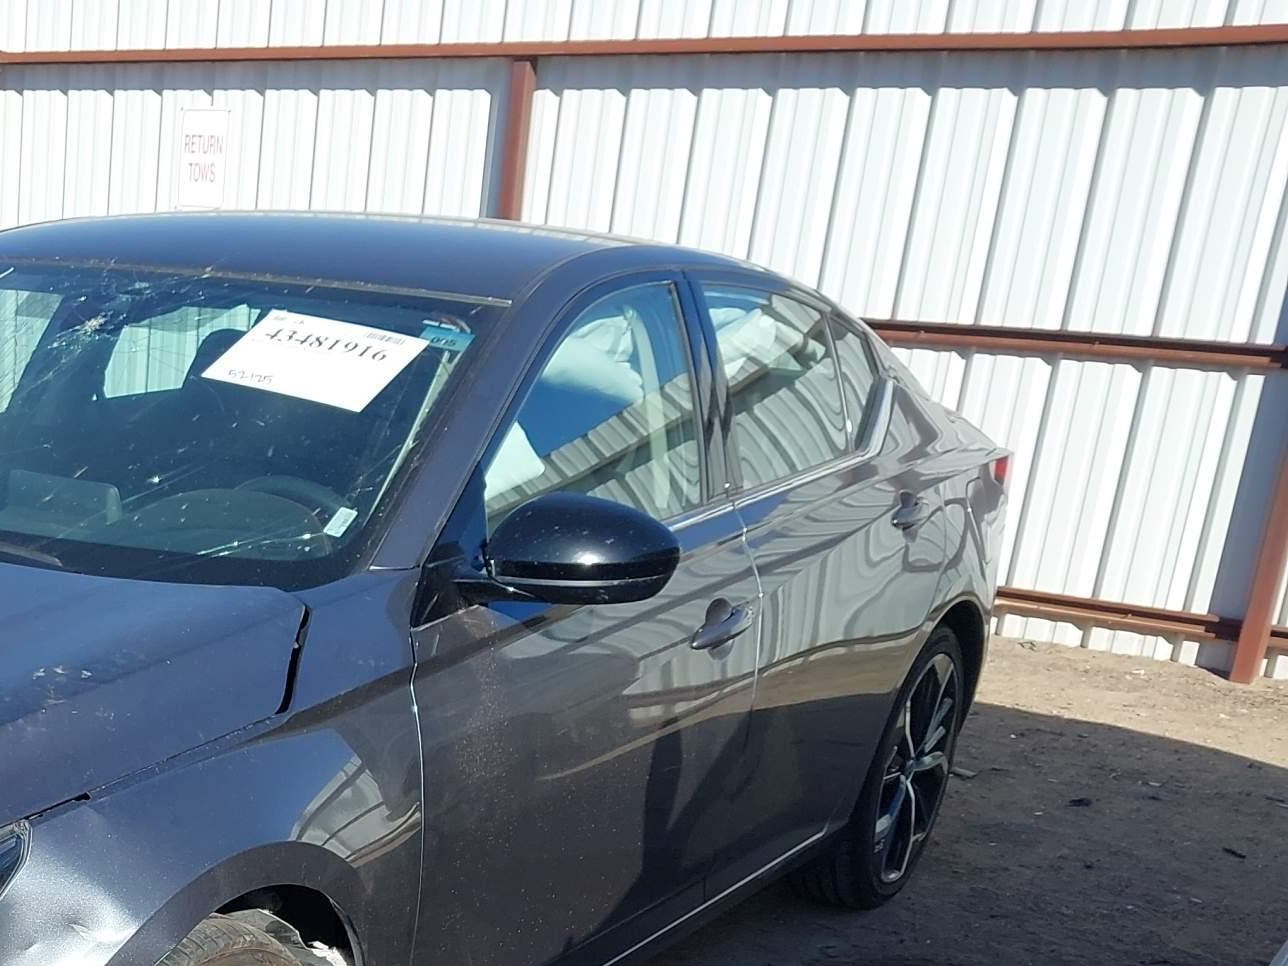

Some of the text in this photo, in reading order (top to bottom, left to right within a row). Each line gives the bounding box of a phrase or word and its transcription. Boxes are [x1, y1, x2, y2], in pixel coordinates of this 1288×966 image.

[184, 134, 224, 154] RETURN
[188, 162, 216, 183] TOWS
[265, 327, 408, 362] 43481916
